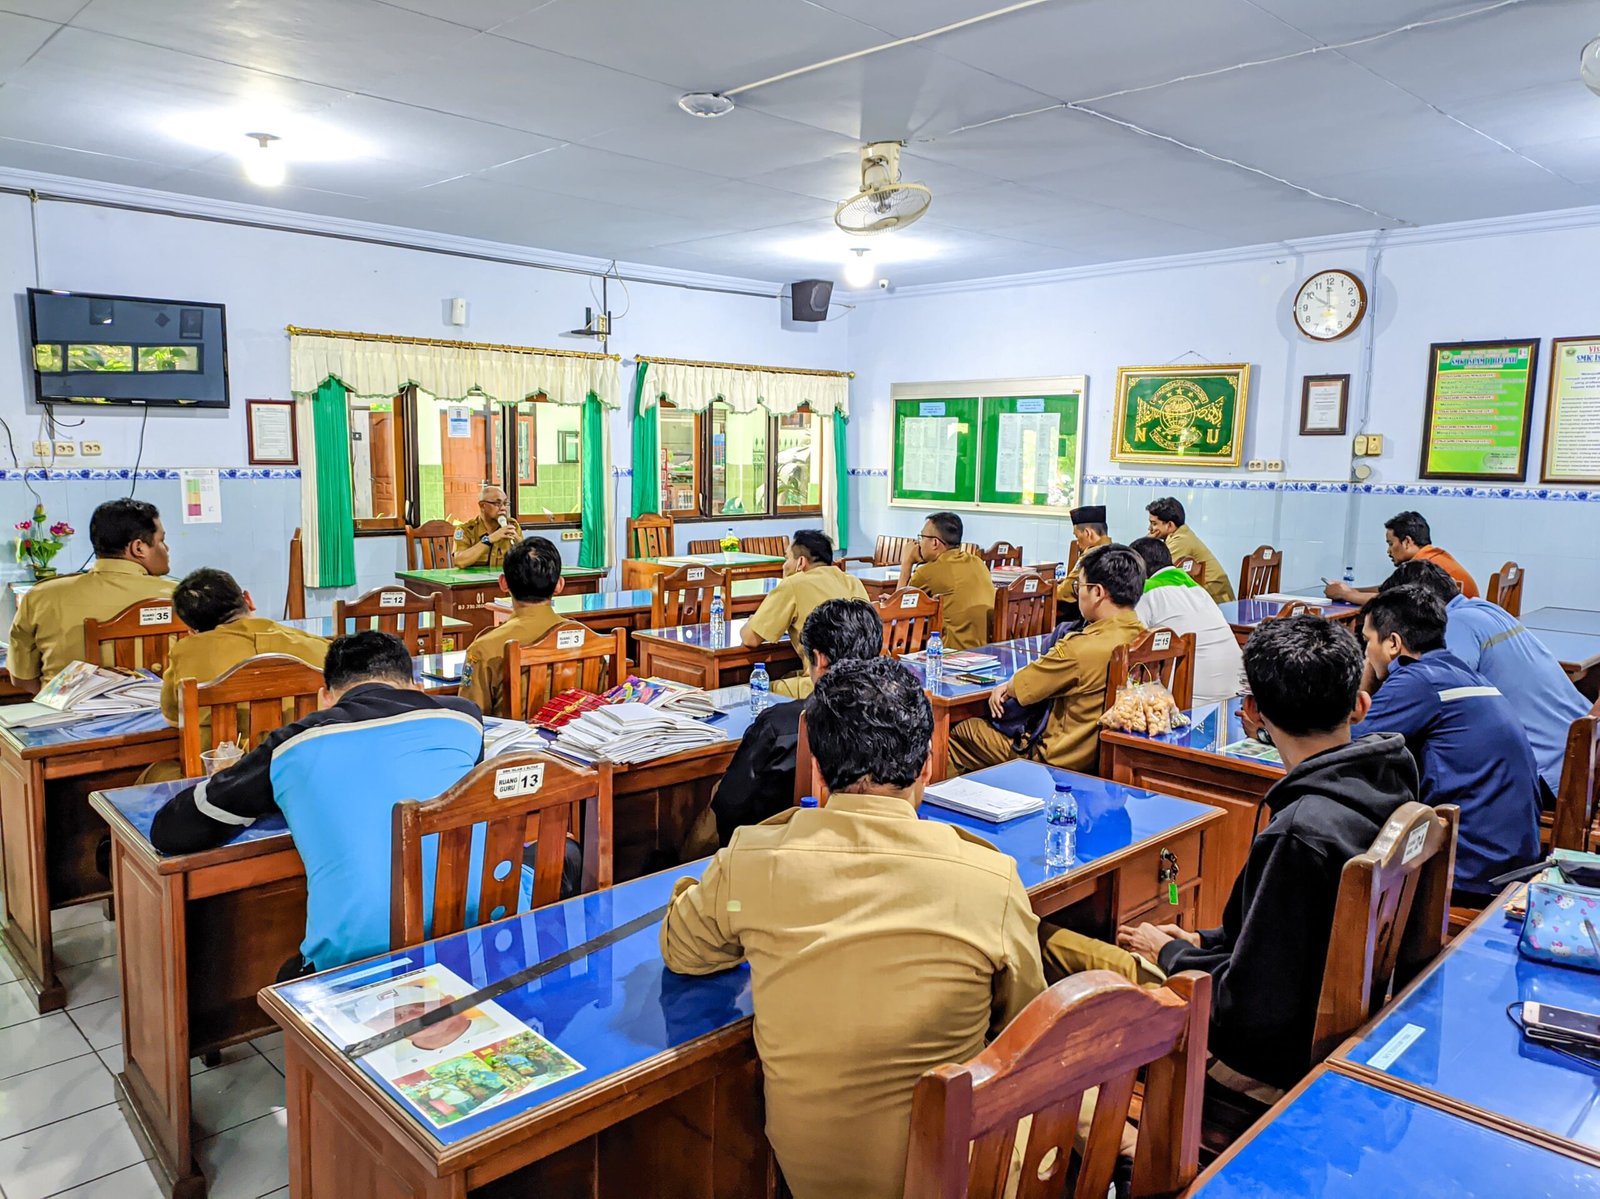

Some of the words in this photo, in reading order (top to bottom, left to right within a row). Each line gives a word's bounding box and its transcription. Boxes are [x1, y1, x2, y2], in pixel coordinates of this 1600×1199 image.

[1326, 278, 1334, 286] 12
[1135, 428, 1146, 442] N
[1207, 429, 1220, 444] U
[156, 612, 168, 620] 35
[574, 635, 579, 643] 3
[499, 777, 517, 785] RUANG
[521, 774, 538, 788] 13
